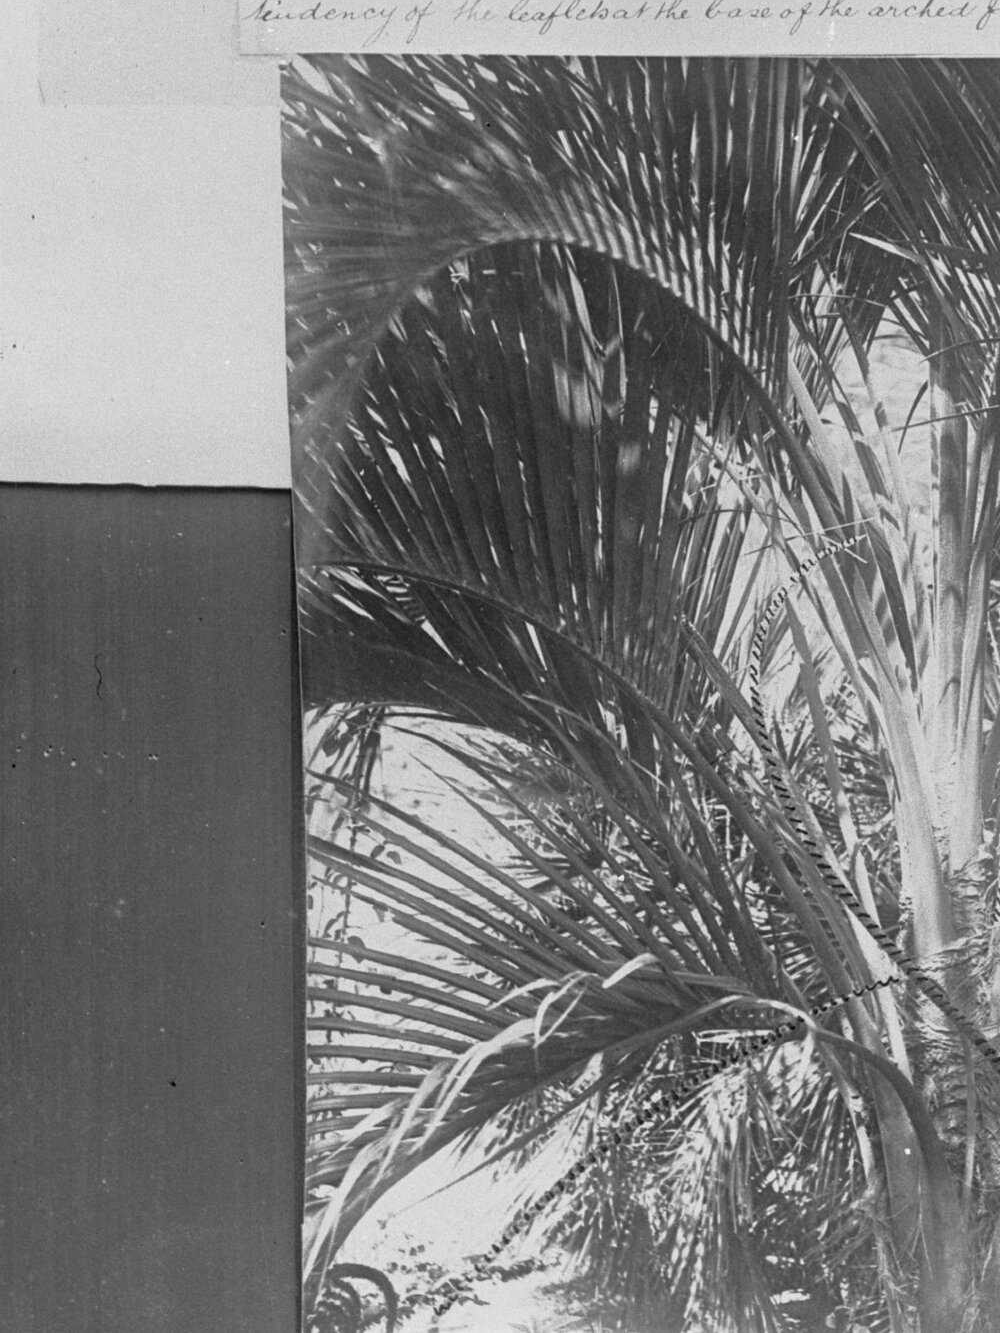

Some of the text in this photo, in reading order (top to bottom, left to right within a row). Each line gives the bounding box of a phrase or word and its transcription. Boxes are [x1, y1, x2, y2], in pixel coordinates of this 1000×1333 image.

[404, 1, 433, 44] of
[612, 5, 652, 20] at
[779, 2, 811, 35] of
